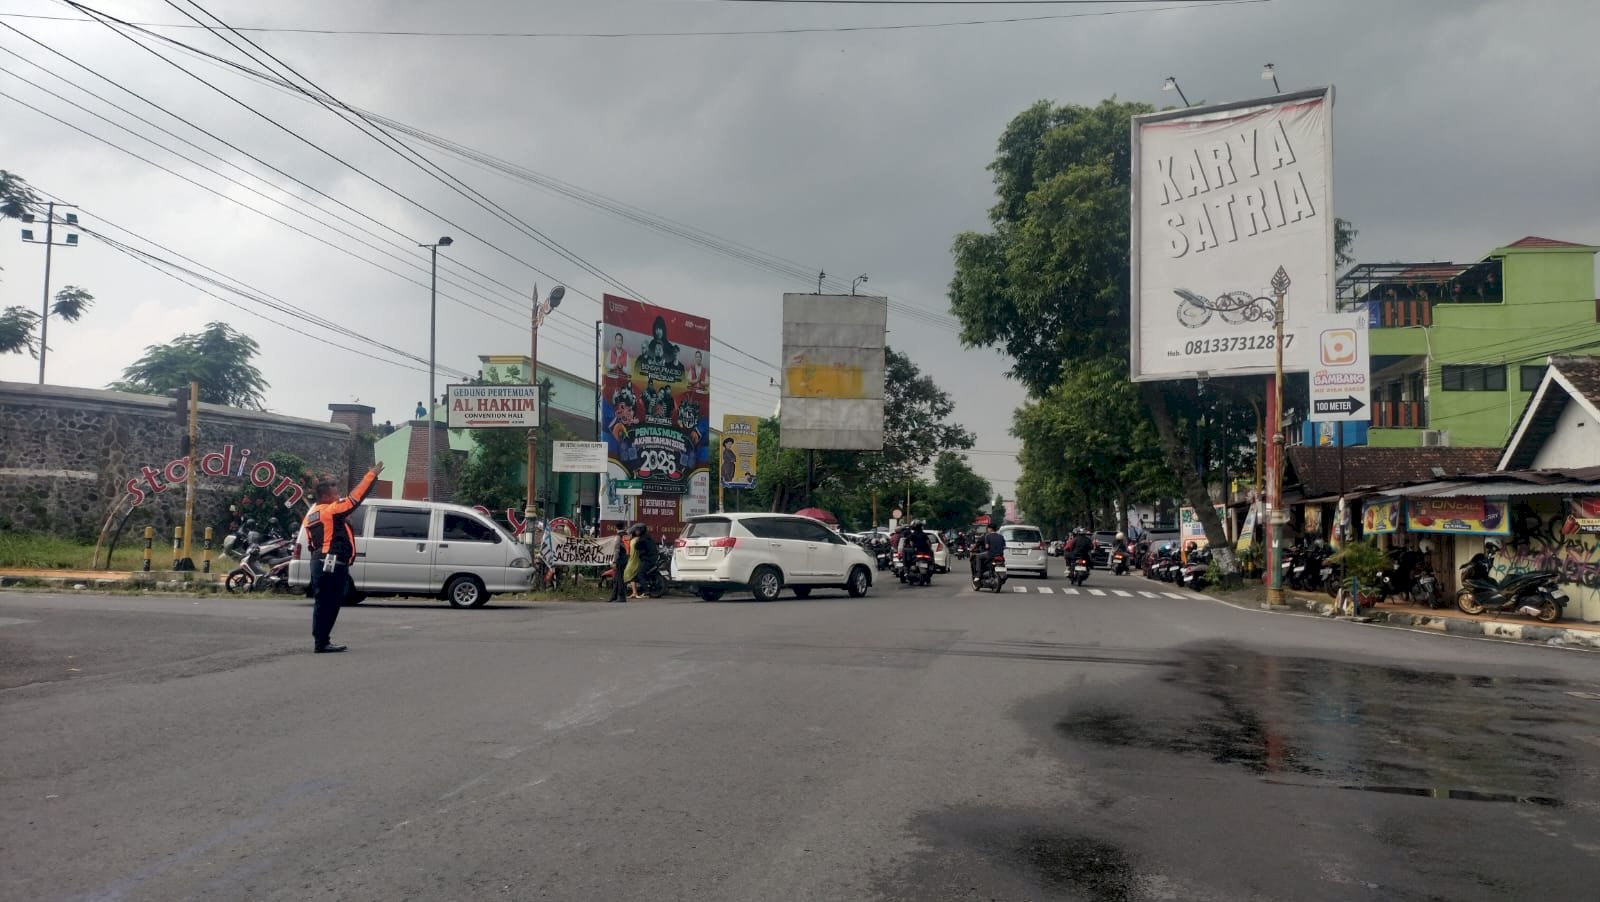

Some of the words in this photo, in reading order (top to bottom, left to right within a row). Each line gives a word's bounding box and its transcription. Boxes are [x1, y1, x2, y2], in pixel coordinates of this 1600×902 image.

[1154, 117, 1297, 206] KARYA
[1164, 170, 1316, 259] SATRIA
[1184, 334, 1294, 355] 08133731287
[1314, 373, 1365, 385] BAMBANG
[454, 389, 486, 397] GEDUNG
[488, 388, 535, 397] PERTEMUAN
[453, 399, 474, 412] AL
[477, 398, 535, 412] HAKIIM
[1316, 402, 1329, 411] 100
[1330, 401, 1351, 410] METER
[635, 427, 662, 438] PENTAS
[126, 444, 304, 509] stadion
